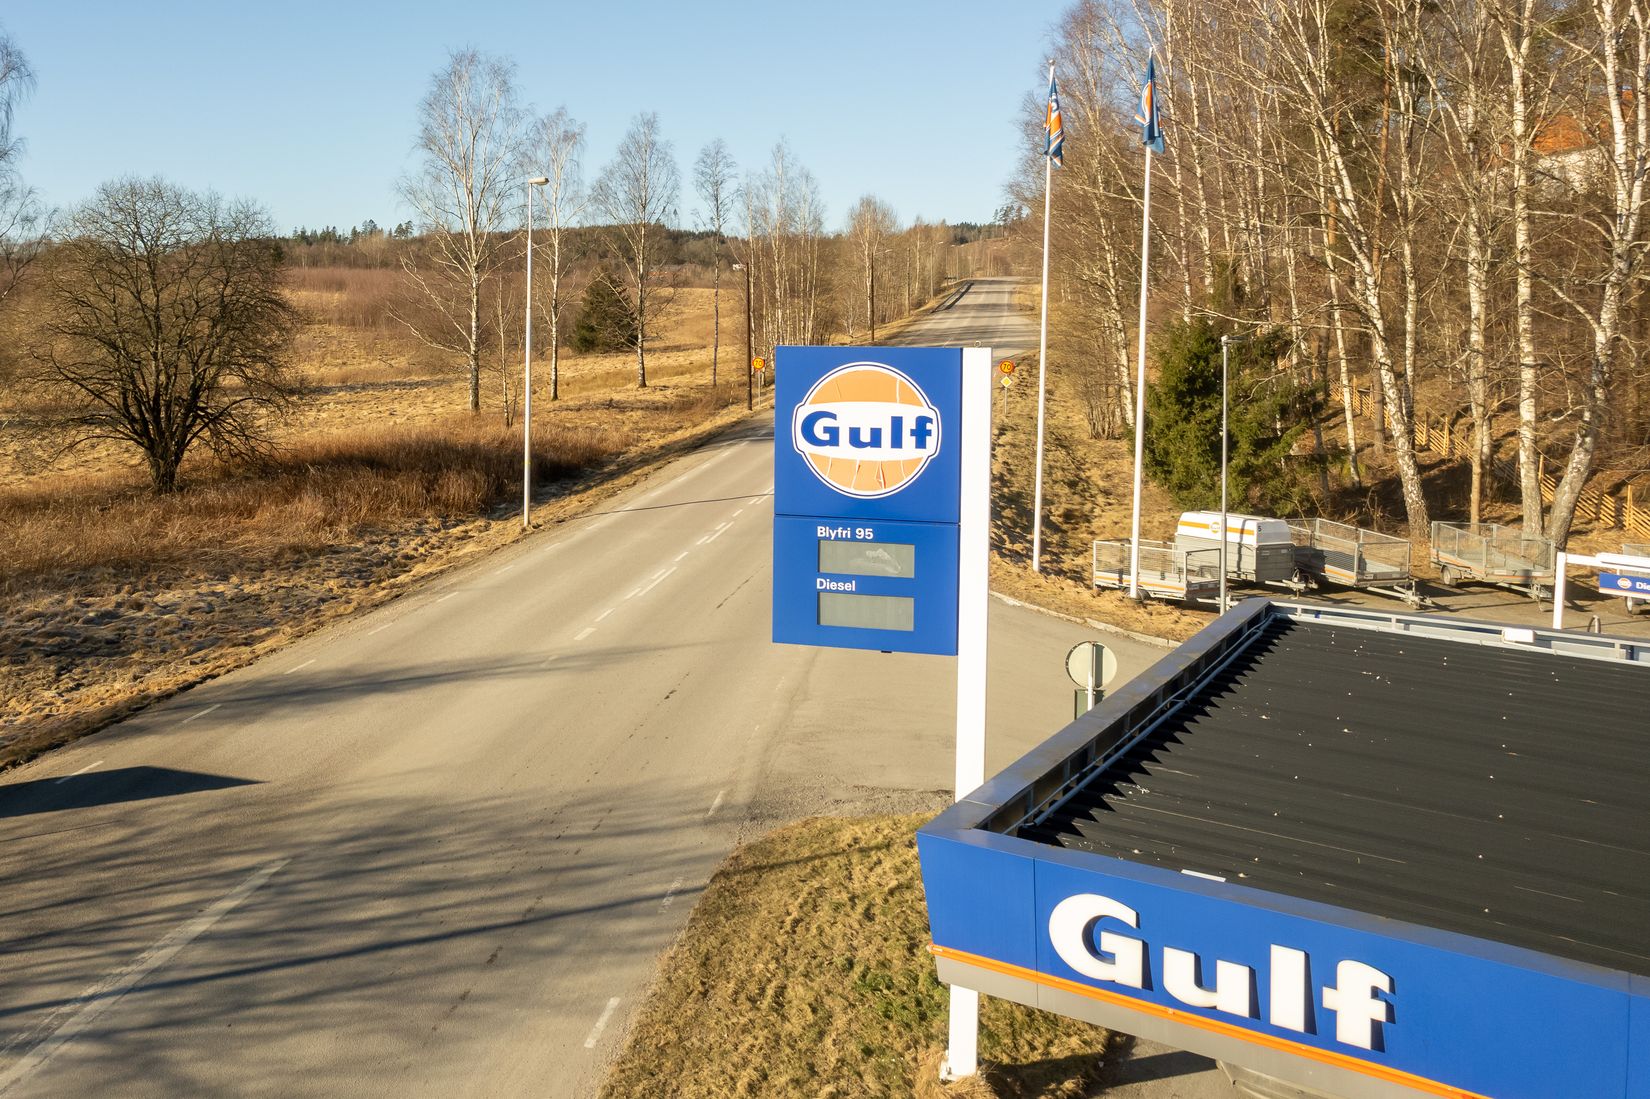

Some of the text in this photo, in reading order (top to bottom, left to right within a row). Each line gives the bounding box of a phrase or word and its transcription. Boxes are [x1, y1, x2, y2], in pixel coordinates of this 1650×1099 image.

[801, 410, 934, 449] Gulf
[817, 526, 874, 540] Blyfri 95
[816, 578, 856, 591] Diesel
[1048, 893, 1393, 1051] Gulf
